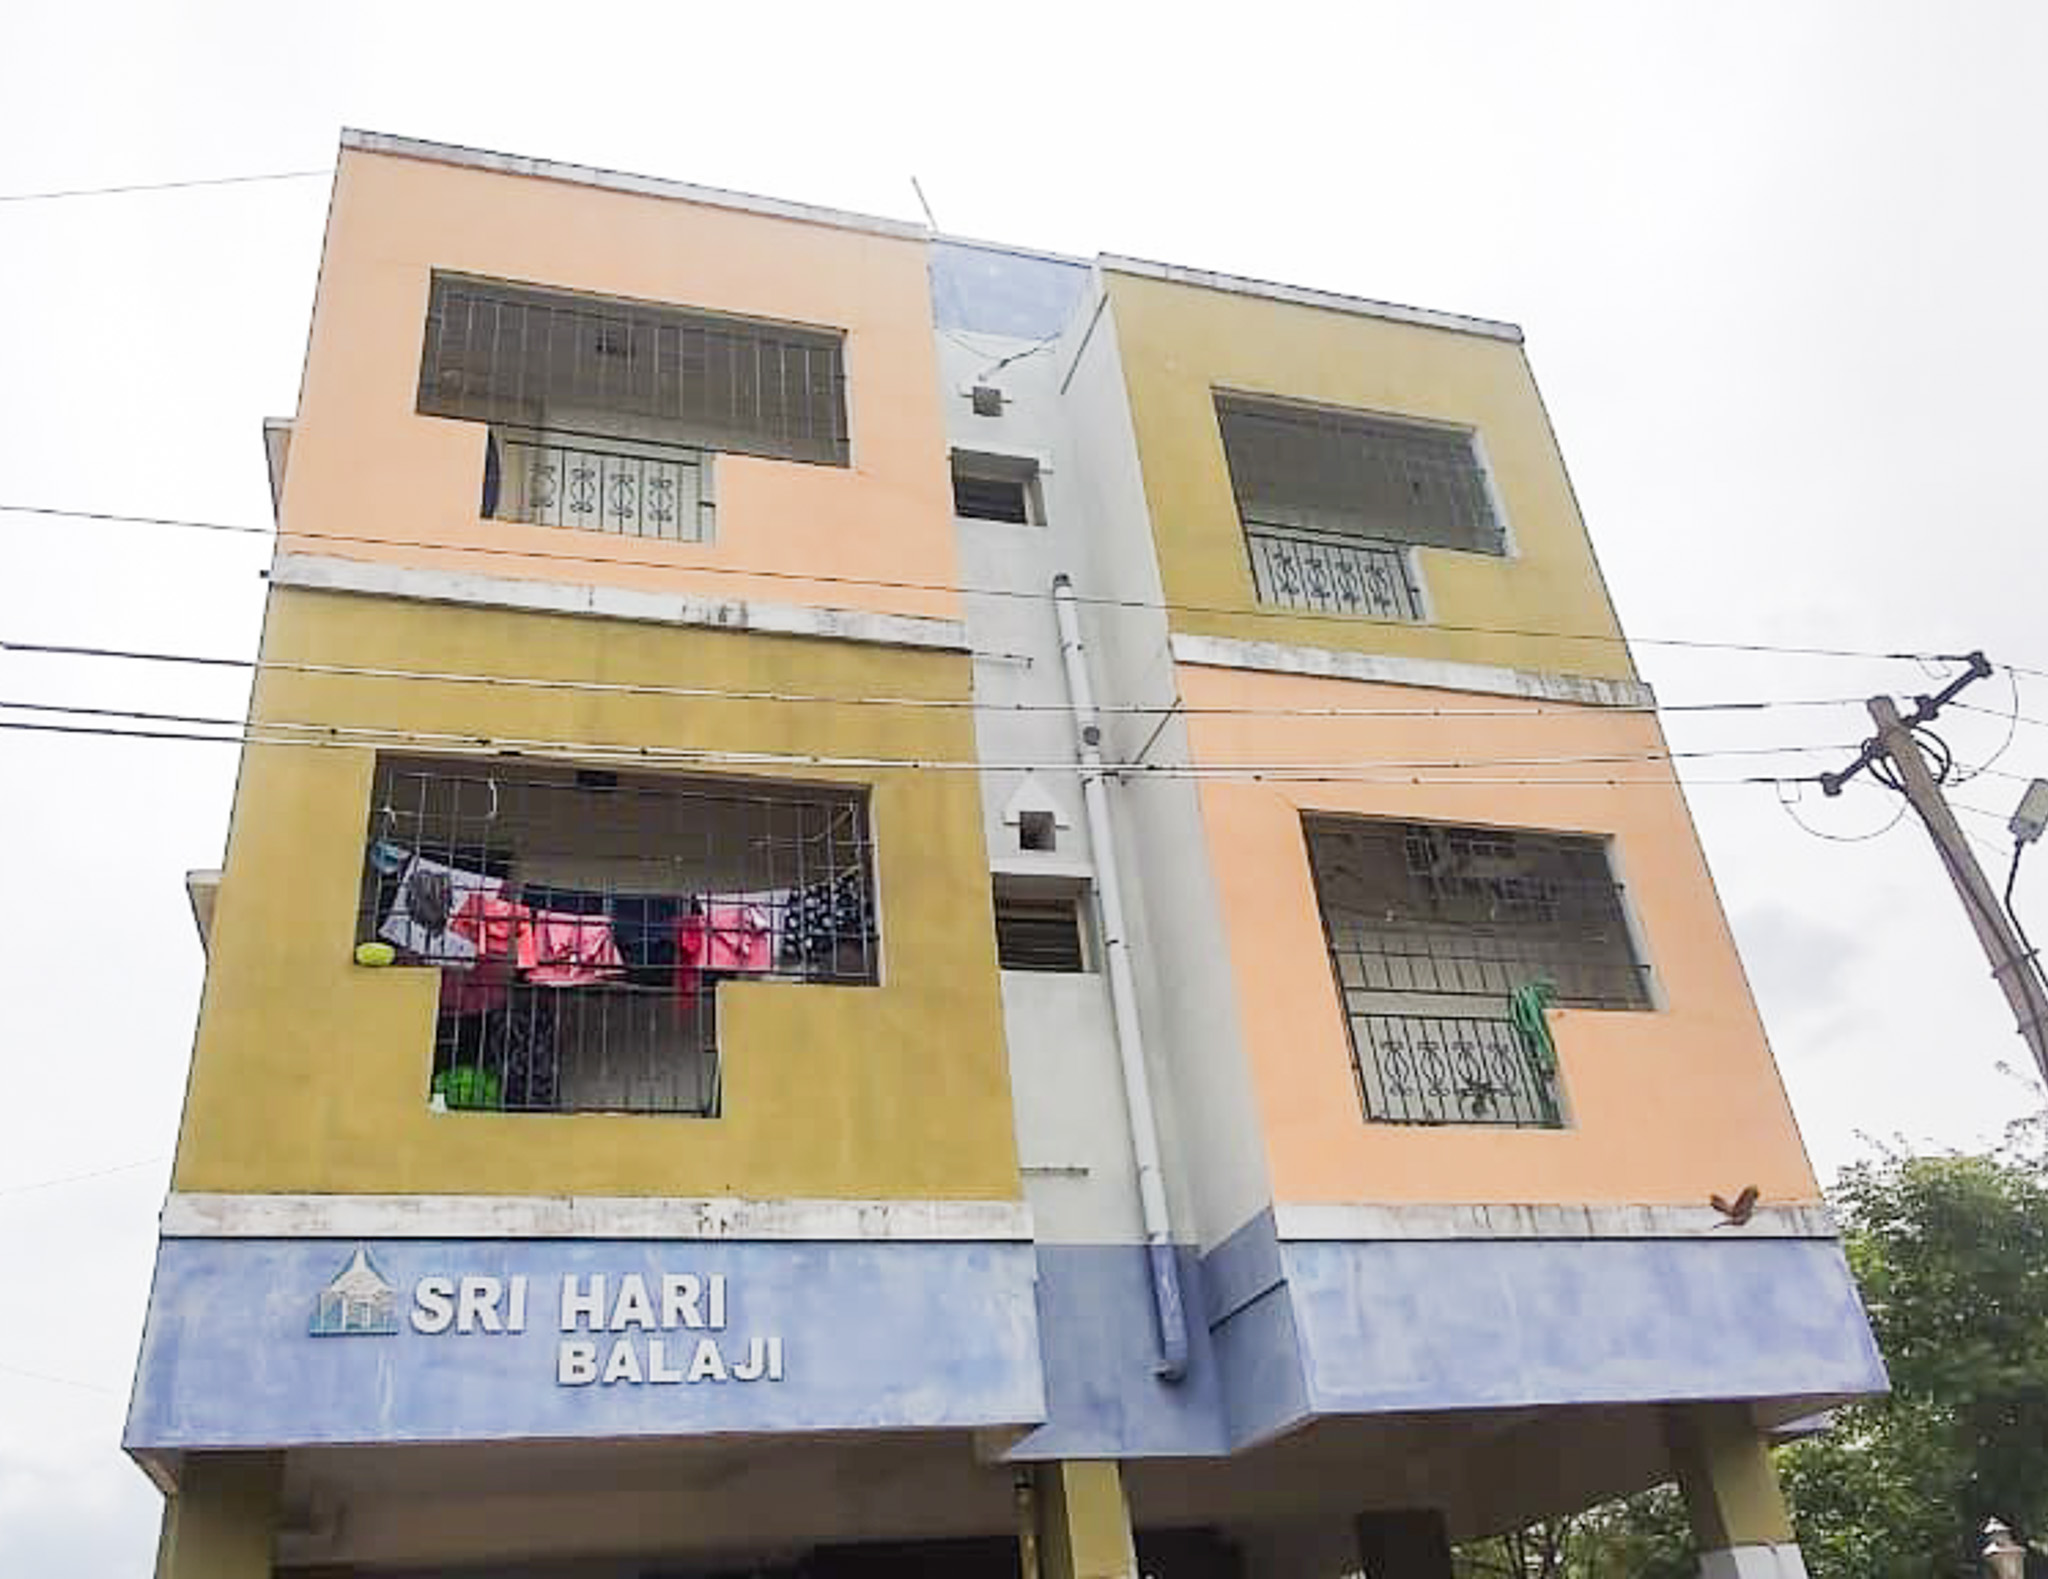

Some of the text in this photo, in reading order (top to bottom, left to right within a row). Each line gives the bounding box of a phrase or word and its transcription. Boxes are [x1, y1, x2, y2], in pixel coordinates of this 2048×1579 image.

[411, 1273, 727, 1334] SRI HARI
[557, 1336, 784, 1386] BALAJI
